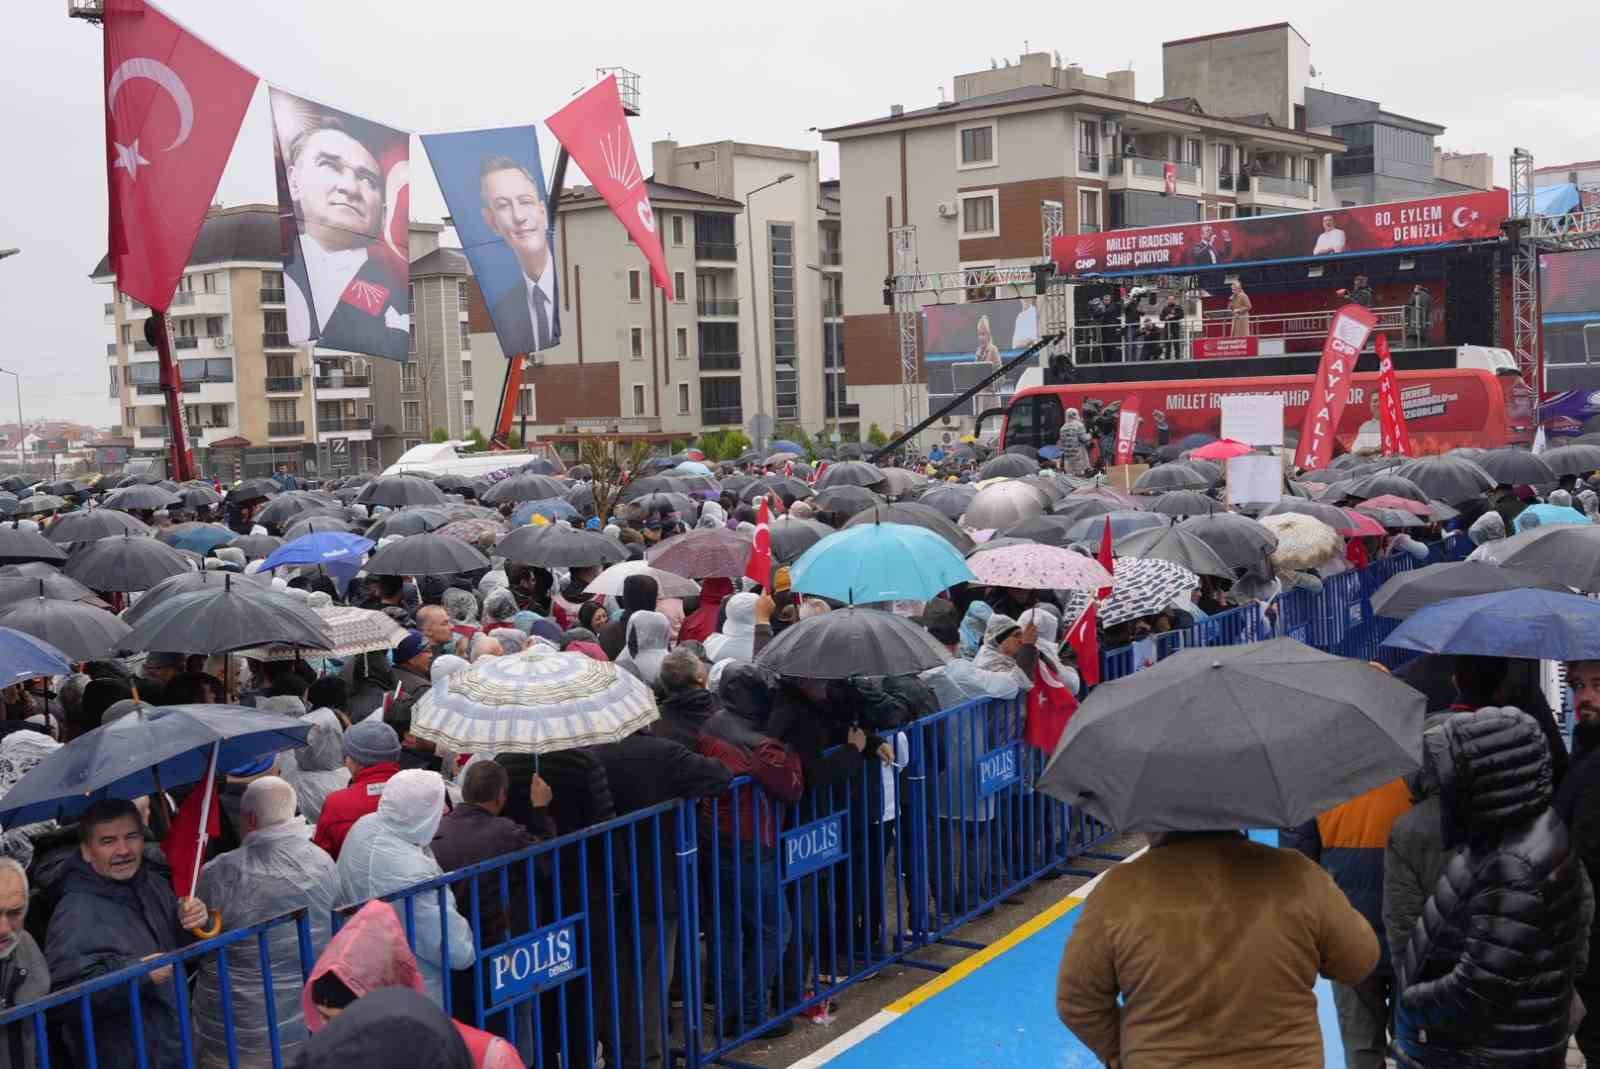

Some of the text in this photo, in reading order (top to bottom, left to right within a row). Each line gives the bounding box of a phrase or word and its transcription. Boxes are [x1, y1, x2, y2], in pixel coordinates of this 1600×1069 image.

[1400, 205, 1442, 224] EYLEM
[1394, 222, 1442, 241] DENİZLİ
[1106, 236, 1137, 251] MİLLET
[1075, 258, 1096, 270] CHP
[1106, 249, 1169, 267] SAHİP ÇIKIYOR
[1166, 393, 1207, 410] MİLLET
[1304, 359, 1344, 468] AYVALIK
